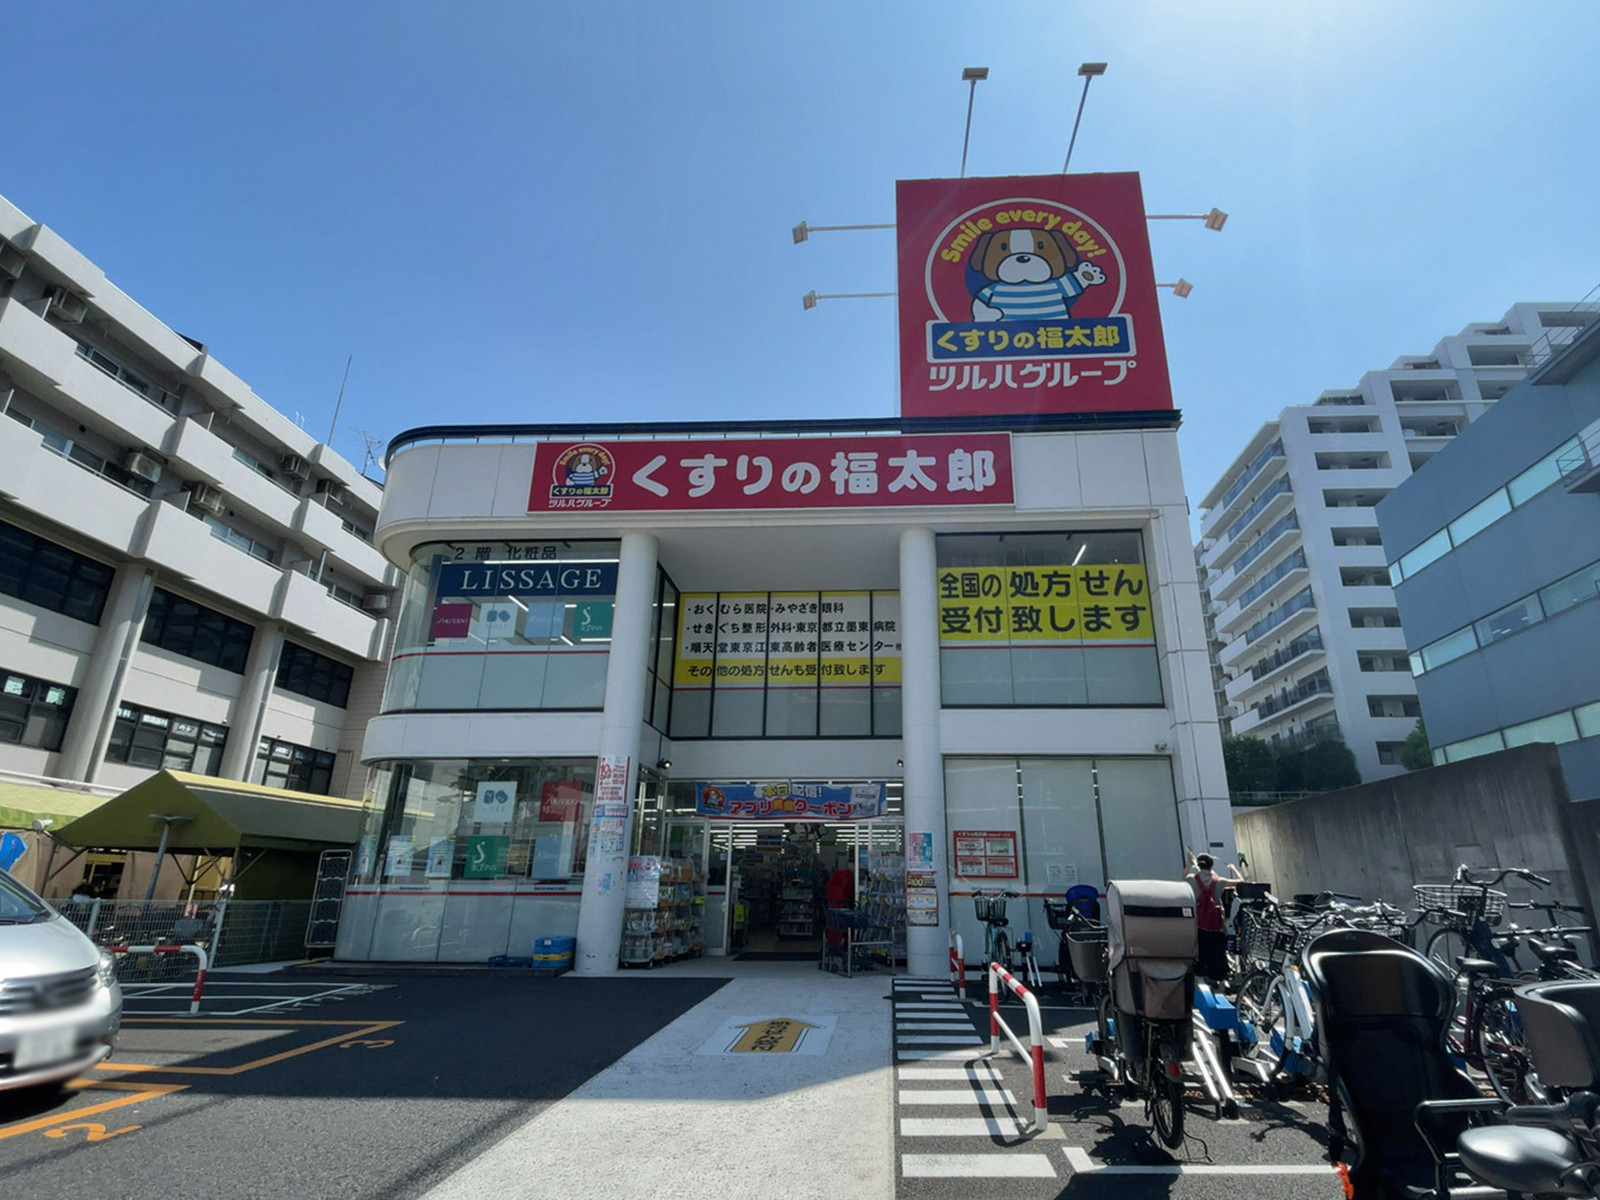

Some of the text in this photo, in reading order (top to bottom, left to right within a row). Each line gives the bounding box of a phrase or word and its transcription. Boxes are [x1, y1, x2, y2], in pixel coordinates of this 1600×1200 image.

[940, 209, 1107, 263] Smile every day!
[936, 325, 1120, 352] くすりの福太郎
[928, 360, 1137, 391] ツルハグループ
[631, 447, 996, 498] くすりの福太郎
[548, 498, 612, 508] ツルハグループ
[460, 568, 602, 590] LISSAGE
[939, 569, 1143, 599] 全国の処方せん
[941, 604, 1147, 634] 受付致します
[687, 663, 886, 677] その他の処方せんも受付致します
[729, 797, 853, 815] アプリクーポン
[43, 1122, 143, 1142] 2
